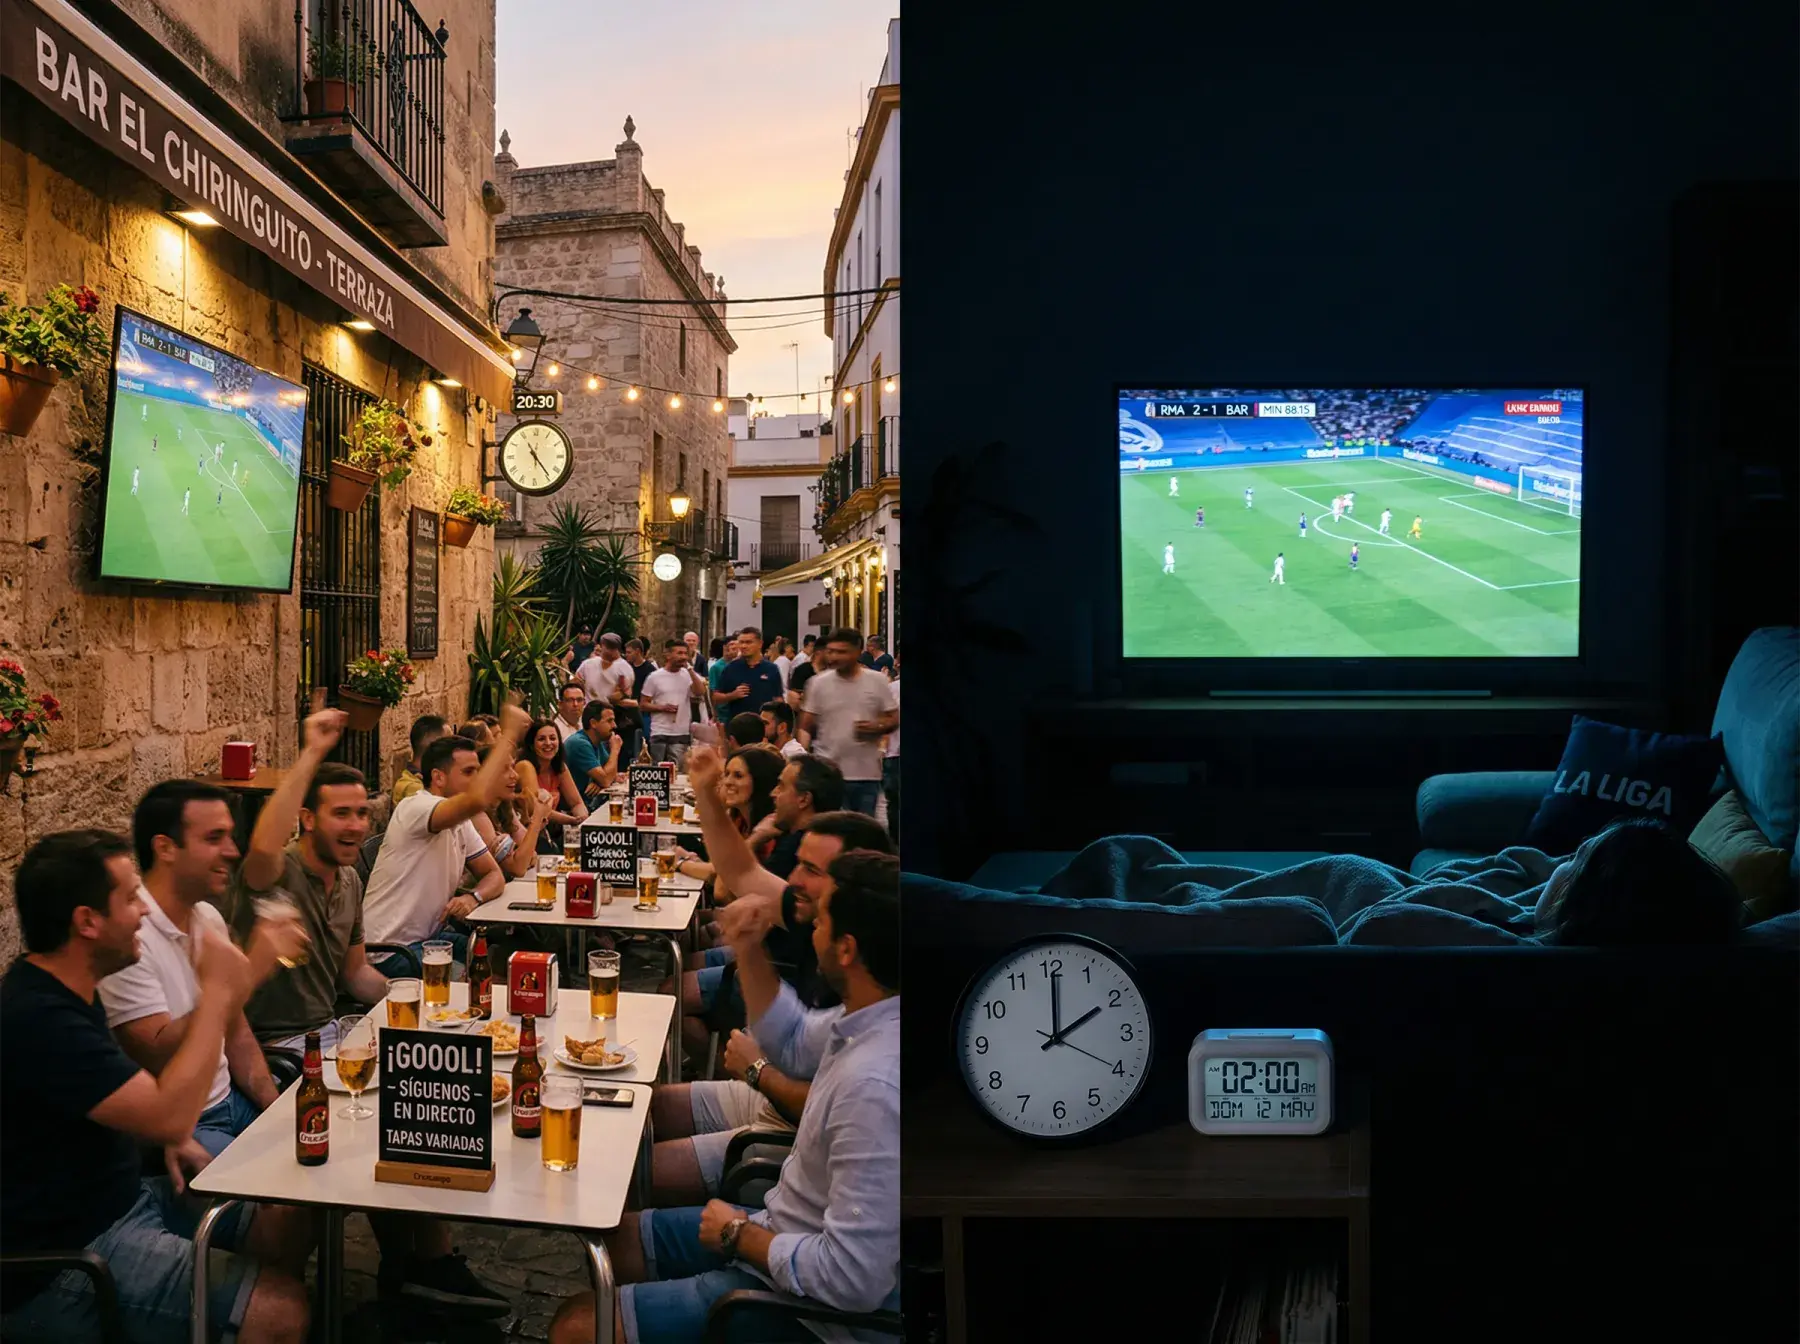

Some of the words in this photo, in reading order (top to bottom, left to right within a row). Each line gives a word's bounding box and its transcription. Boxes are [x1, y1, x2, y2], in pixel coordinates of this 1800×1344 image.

[36, 26, 111, 132] BAR
[120, 92, 155, 164] EL
[163, 130, 311, 270] CHIRINGUITO
[326, 249, 395, 329] TERRAZA
[516, 395, 554, 409] 20:30
[1160, 404, 1185, 416] RMA
[1226, 404, 1249, 416] BAR
[1263, 405, 1282, 415] MIN
[1553, 770, 1591, 796] LA
[1596, 773, 1672, 815] LIGA
[585, 831, 633, 847] ¡GOOOL!
[1039, 959, 1064, 979] 12
[1082, 965, 1091, 984] 1
[1006, 971, 1026, 991] 11
[1108, 989, 1122, 1008] 2
[982, 1000, 1006, 1019] 10
[1120, 1023, 1134, 1042] 3
[975, 1035, 989, 1055] 9
[388, 1041, 482, 1074] ¡GOOOL!
[1111, 1059, 1126, 1078] 4
[1222, 1061, 1299, 1094] 02:00
[1301, 1082, 1316, 1093] AM
[399, 1076, 471, 1102] SÍGUENOS
[988, 1070, 1003, 1090] 8
[1016, 1094, 1031, 1113] 7
[1087, 1087, 1101, 1107] 5
[393, 1101, 412, 1120] EN
[416, 1103, 475, 1125] DIRECTO
[1052, 1100, 1067, 1120] 6
[1210, 1101, 1243, 1118] DOM
[1257, 1101, 1271, 1118] 12
[1280, 1101, 1315, 1118] MAY
[386, 1128, 423, 1146] TAPAS
[425, 1132, 484, 1152] VARIADAS
